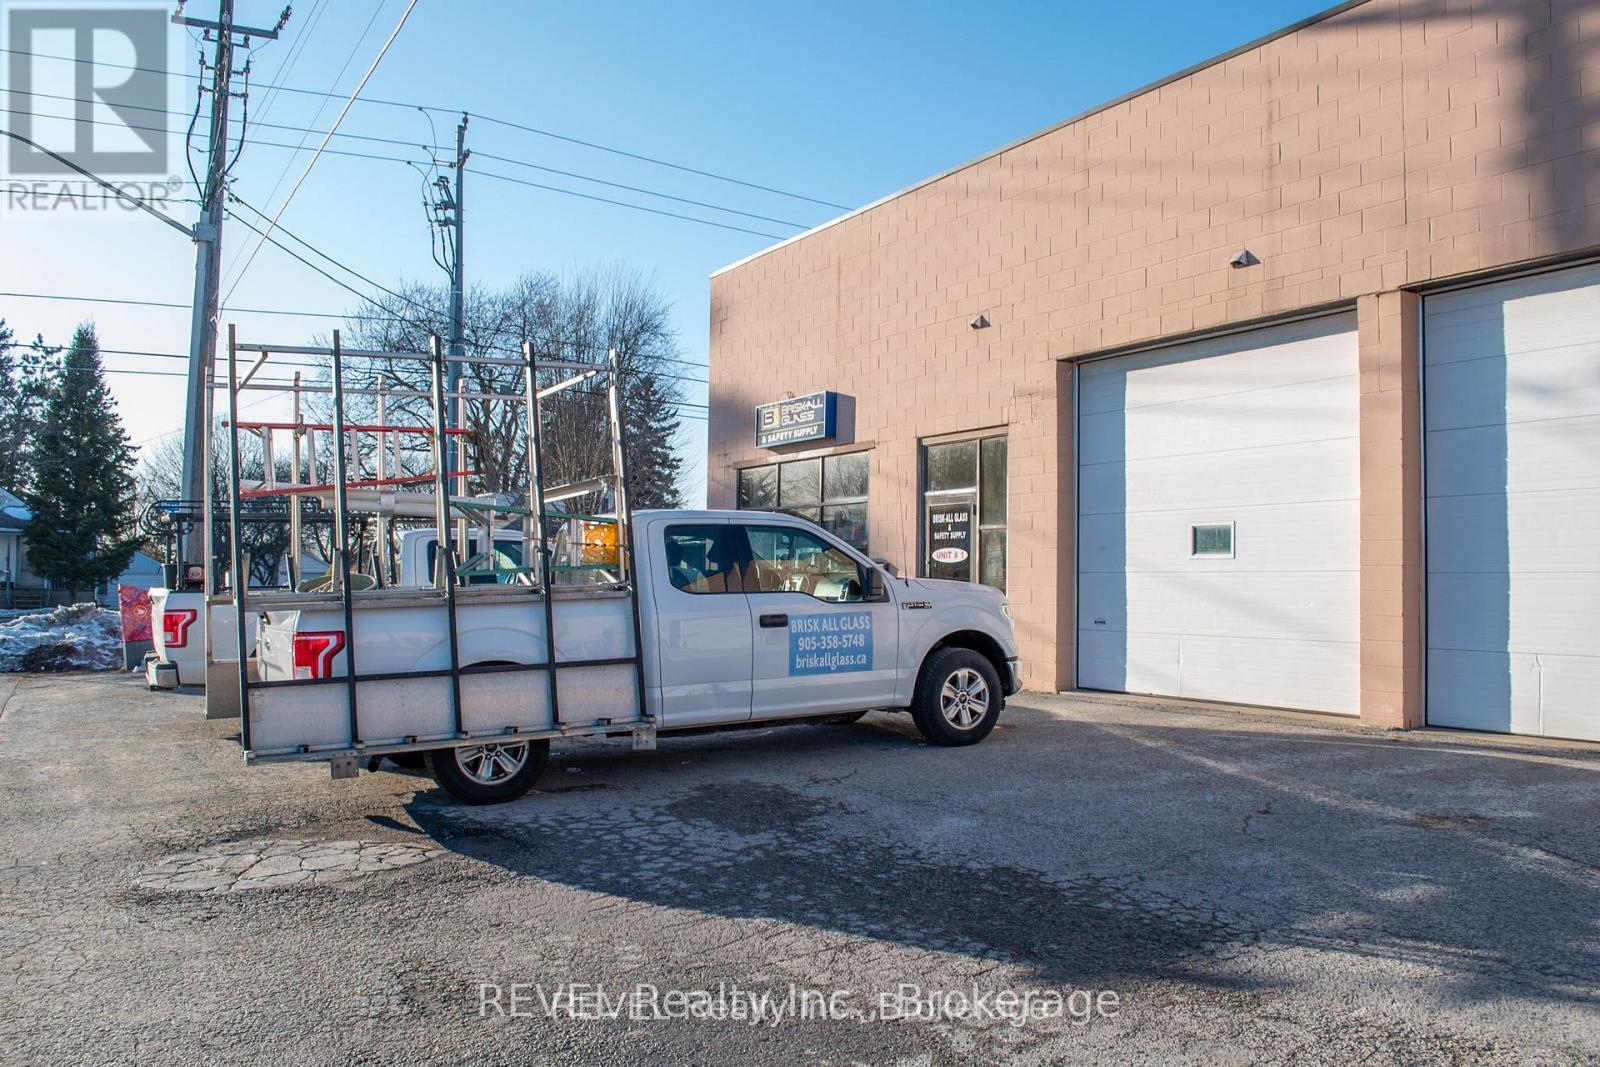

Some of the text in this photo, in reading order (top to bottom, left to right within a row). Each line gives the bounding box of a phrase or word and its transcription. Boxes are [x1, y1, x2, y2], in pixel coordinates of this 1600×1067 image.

[781, 411, 815, 425] GLASS
[768, 431, 792, 442] SAFETY
[793, 425, 818, 437] SUPPLY
[954, 512, 968, 522] GLASS
[934, 531, 966, 540] SAFETY SUPPLY
[791, 616, 871, 633] BRISK ALL GLASS
[798, 634, 865, 651] 905-358-5748
[796, 652, 867, 670] briskallglass.ca
